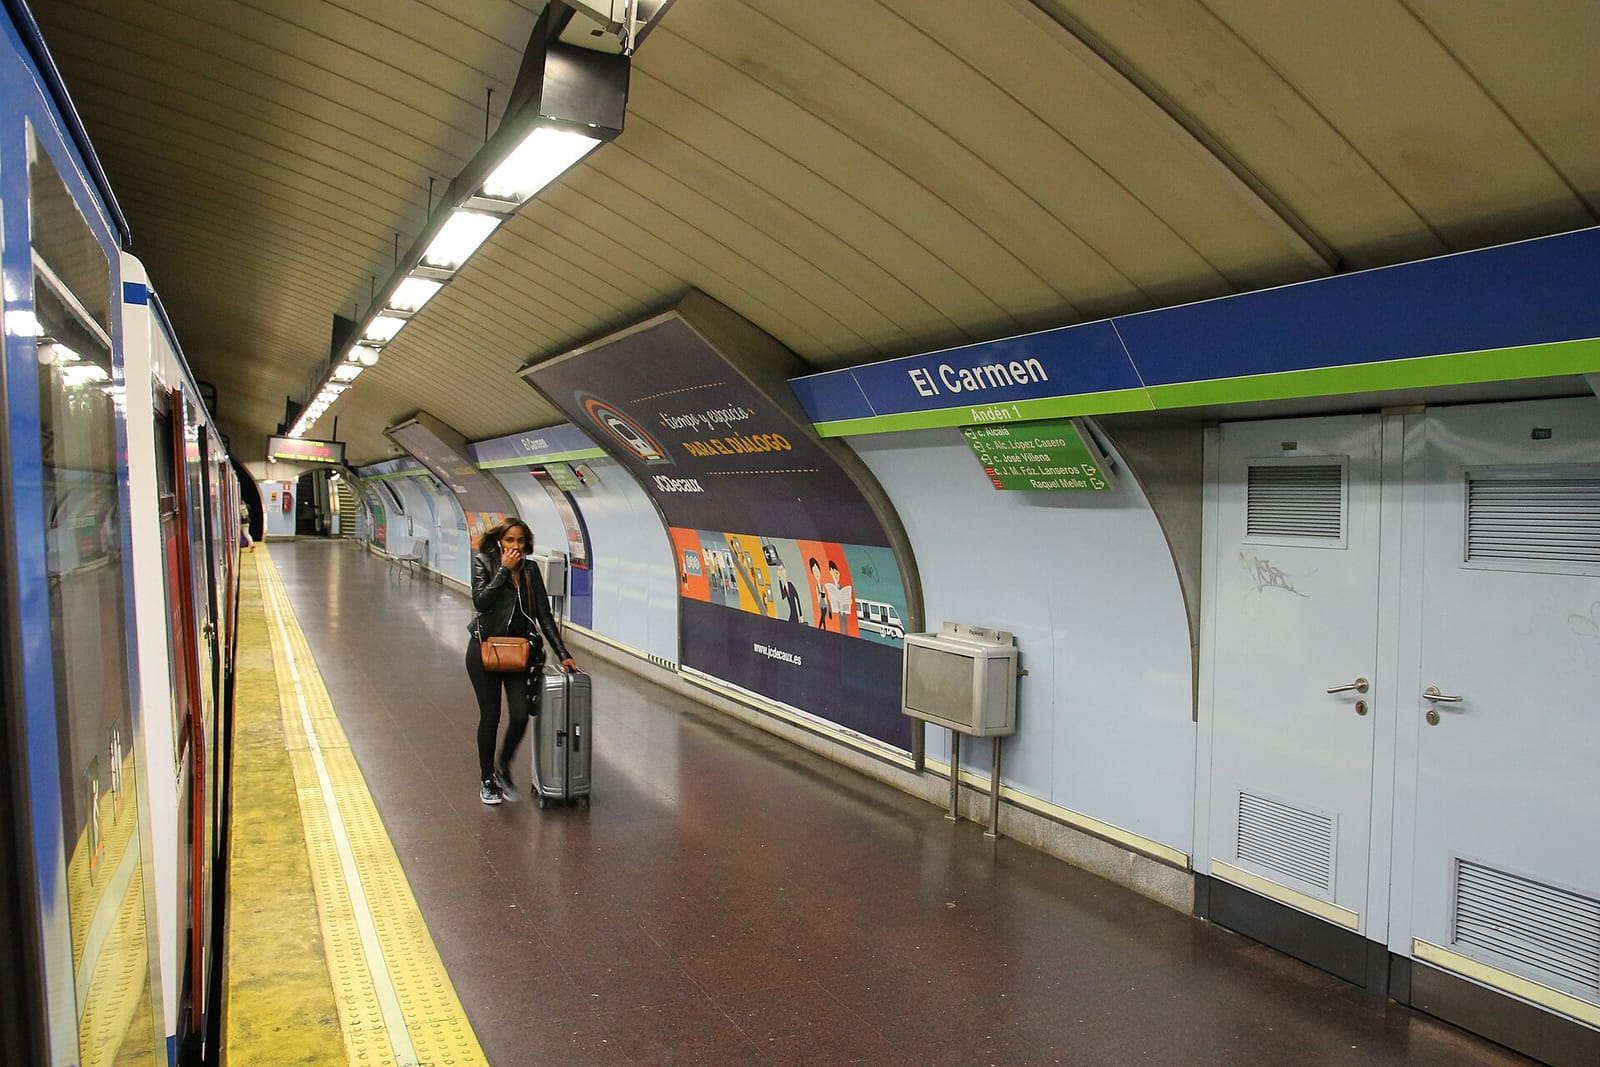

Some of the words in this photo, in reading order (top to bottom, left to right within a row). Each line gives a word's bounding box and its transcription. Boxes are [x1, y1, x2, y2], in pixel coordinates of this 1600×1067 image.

[908, 368, 940, 397] El
[938, 357, 1049, 394] Carmen
[659, 412, 700, 433] tiempo
[699, 414, 715, 431] y
[707, 402, 750, 429] espacio
[971, 407, 1011, 422] Andén
[1012, 404, 1022, 418] 1
[977, 430, 986, 438] c.
[986, 426, 1010, 437] Alcalá
[682, 441, 717, 457] PARA
[709, 439, 735, 455] EL
[985, 442, 994, 450] c.
[1009, 437, 1035, 451] López
[1035, 434, 1066, 448] Casero
[993, 454, 1003, 463] c.
[1002, 452, 1023, 463] José
[1021, 452, 1051, 463] Villena
[1001, 467, 1011, 476] J.
[1010, 468, 1021, 476] M.
[1020, 467, 1040, 476] Fdz.
[1040, 463, 1080, 475] Lanseros
[652, 475, 704, 493] JCDecaux
[1030, 478, 1063, 490] Raquel
[1060, 477, 1088, 488] Meller
[753, 643, 802, 666] www.jcdecaux.es
